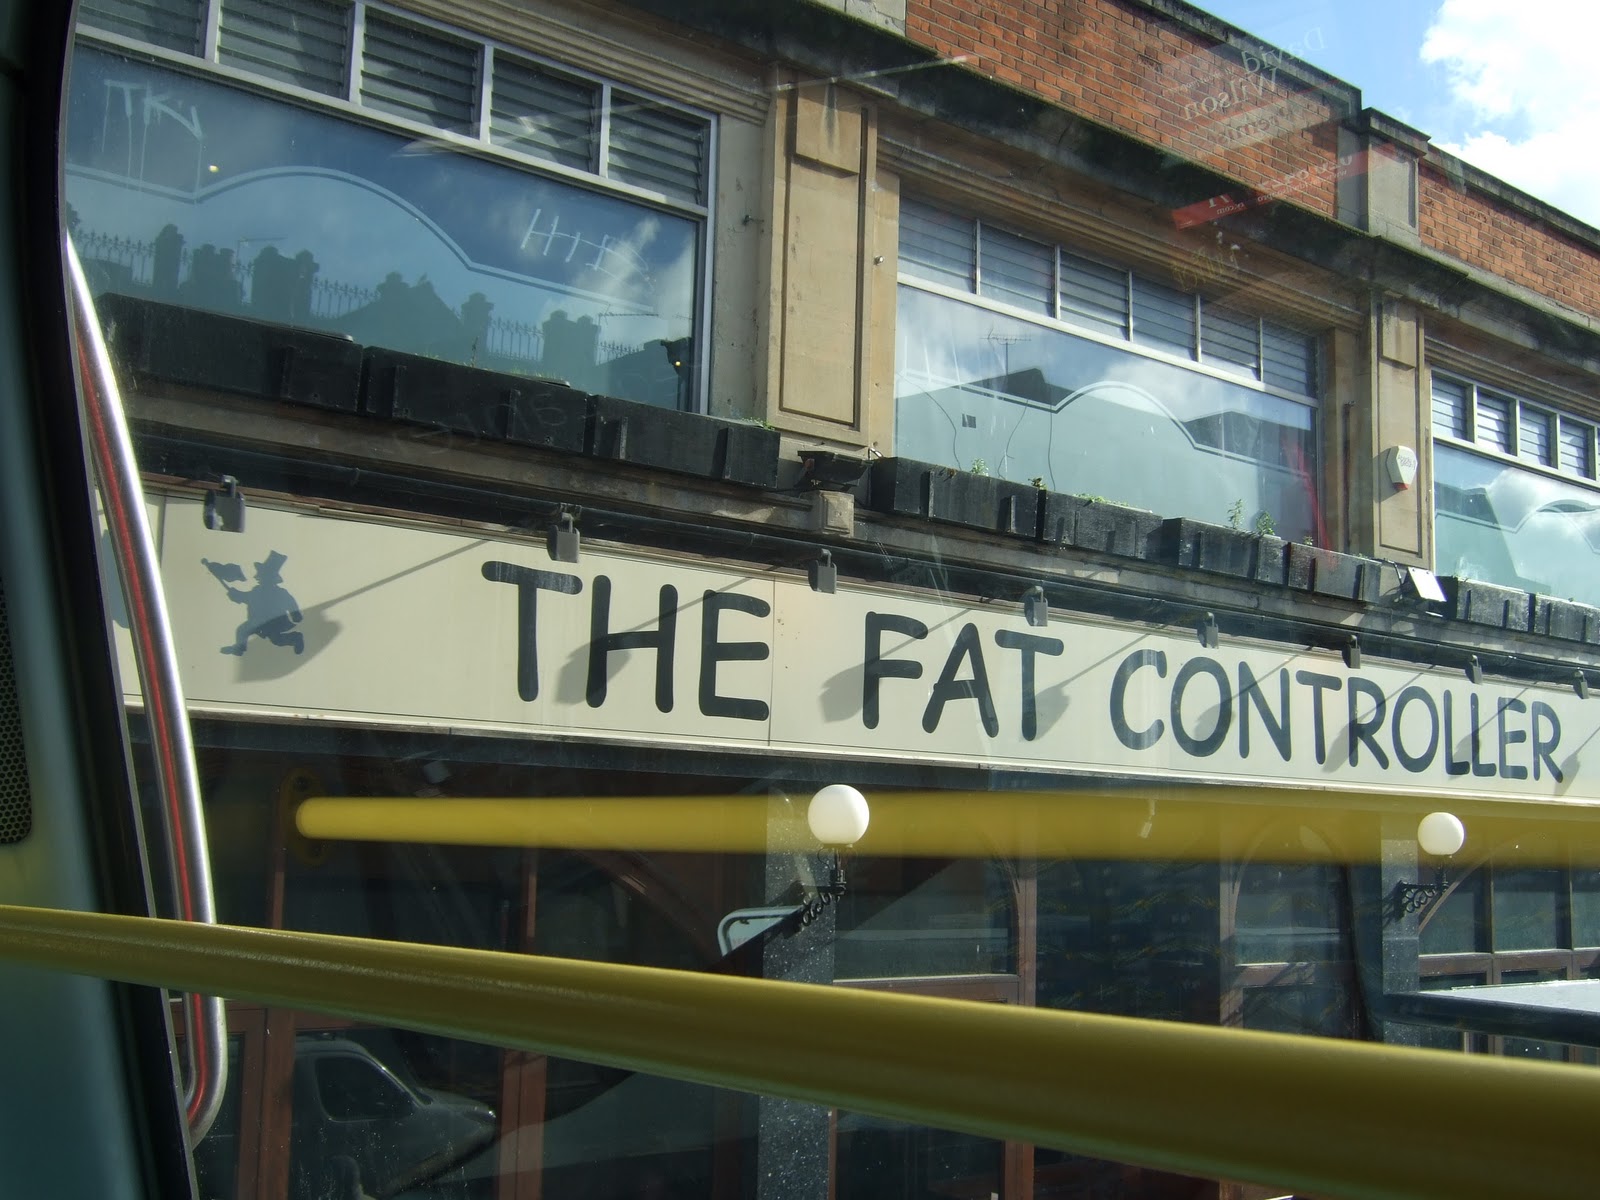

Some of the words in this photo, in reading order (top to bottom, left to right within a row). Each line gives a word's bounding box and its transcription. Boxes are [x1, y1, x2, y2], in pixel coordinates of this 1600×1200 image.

[481, 559, 770, 721] THE
[863, 610, 1064, 742] FAT
[1109, 648, 1563, 784] CONTROLLER
